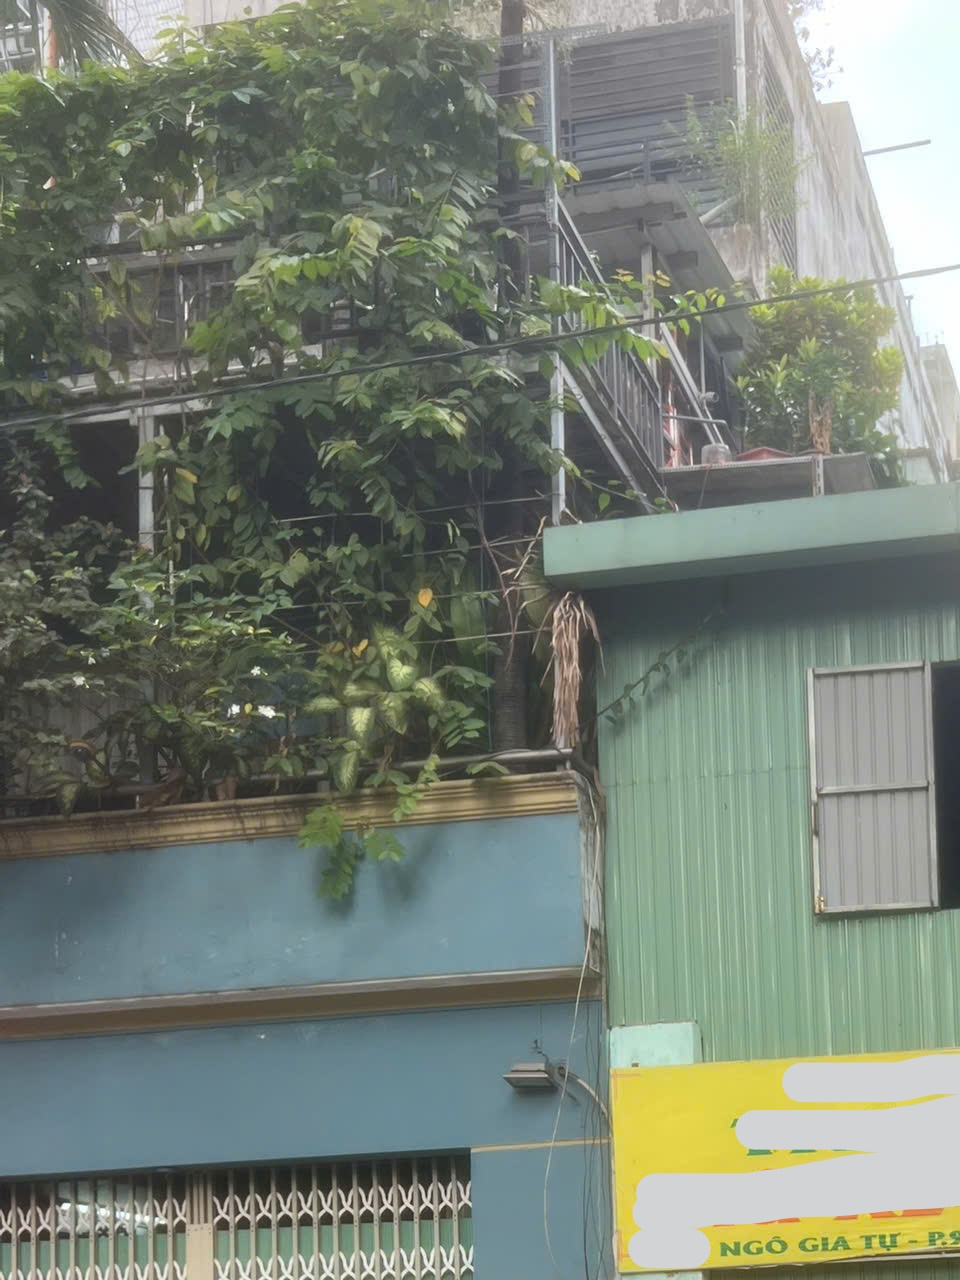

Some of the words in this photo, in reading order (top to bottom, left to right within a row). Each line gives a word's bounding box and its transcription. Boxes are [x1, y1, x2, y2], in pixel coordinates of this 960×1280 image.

[719, 1235, 788, 1256] NGÔ
[798, 1235, 851, 1252] GIA
[860, 1231, 902, 1251] TỰ
